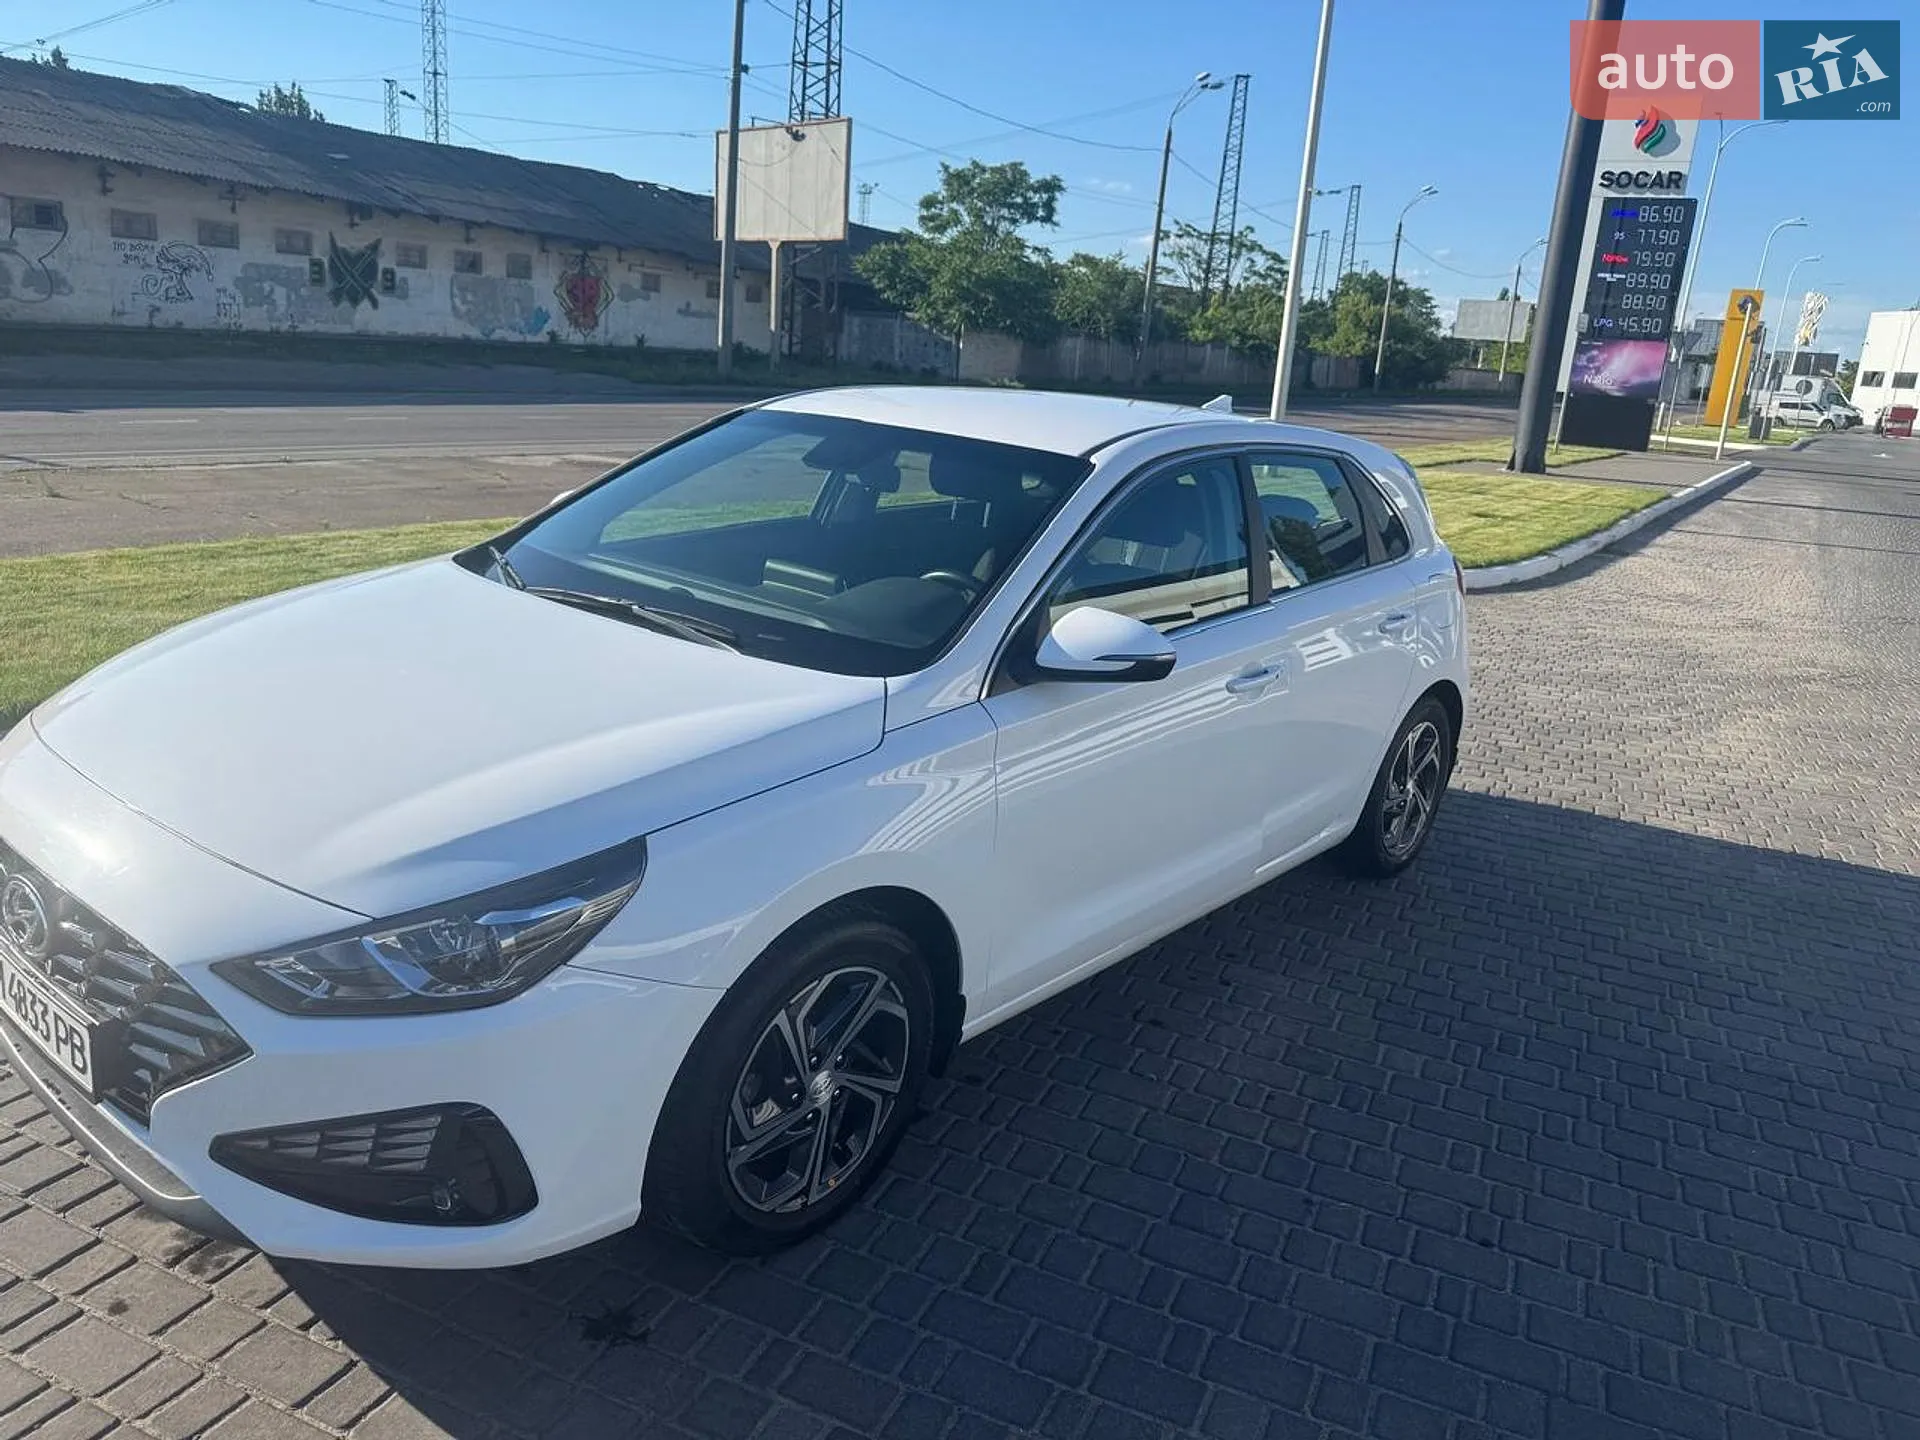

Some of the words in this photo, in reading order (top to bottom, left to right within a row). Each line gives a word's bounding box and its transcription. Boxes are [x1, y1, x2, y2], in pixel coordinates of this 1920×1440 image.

[1599, 170, 1683, 189] SOCAR
[1638, 205, 1685, 223] 86.90
[1637, 229, 1680, 246] 77.90
[1633, 250, 1676, 267] 79.90
[1626, 272, 1671, 289] 89.90
[1618, 316, 1662, 333] 45.90
[8, 972, 51, 1043] 4833
[52, 1010, 88, 1075] PB
